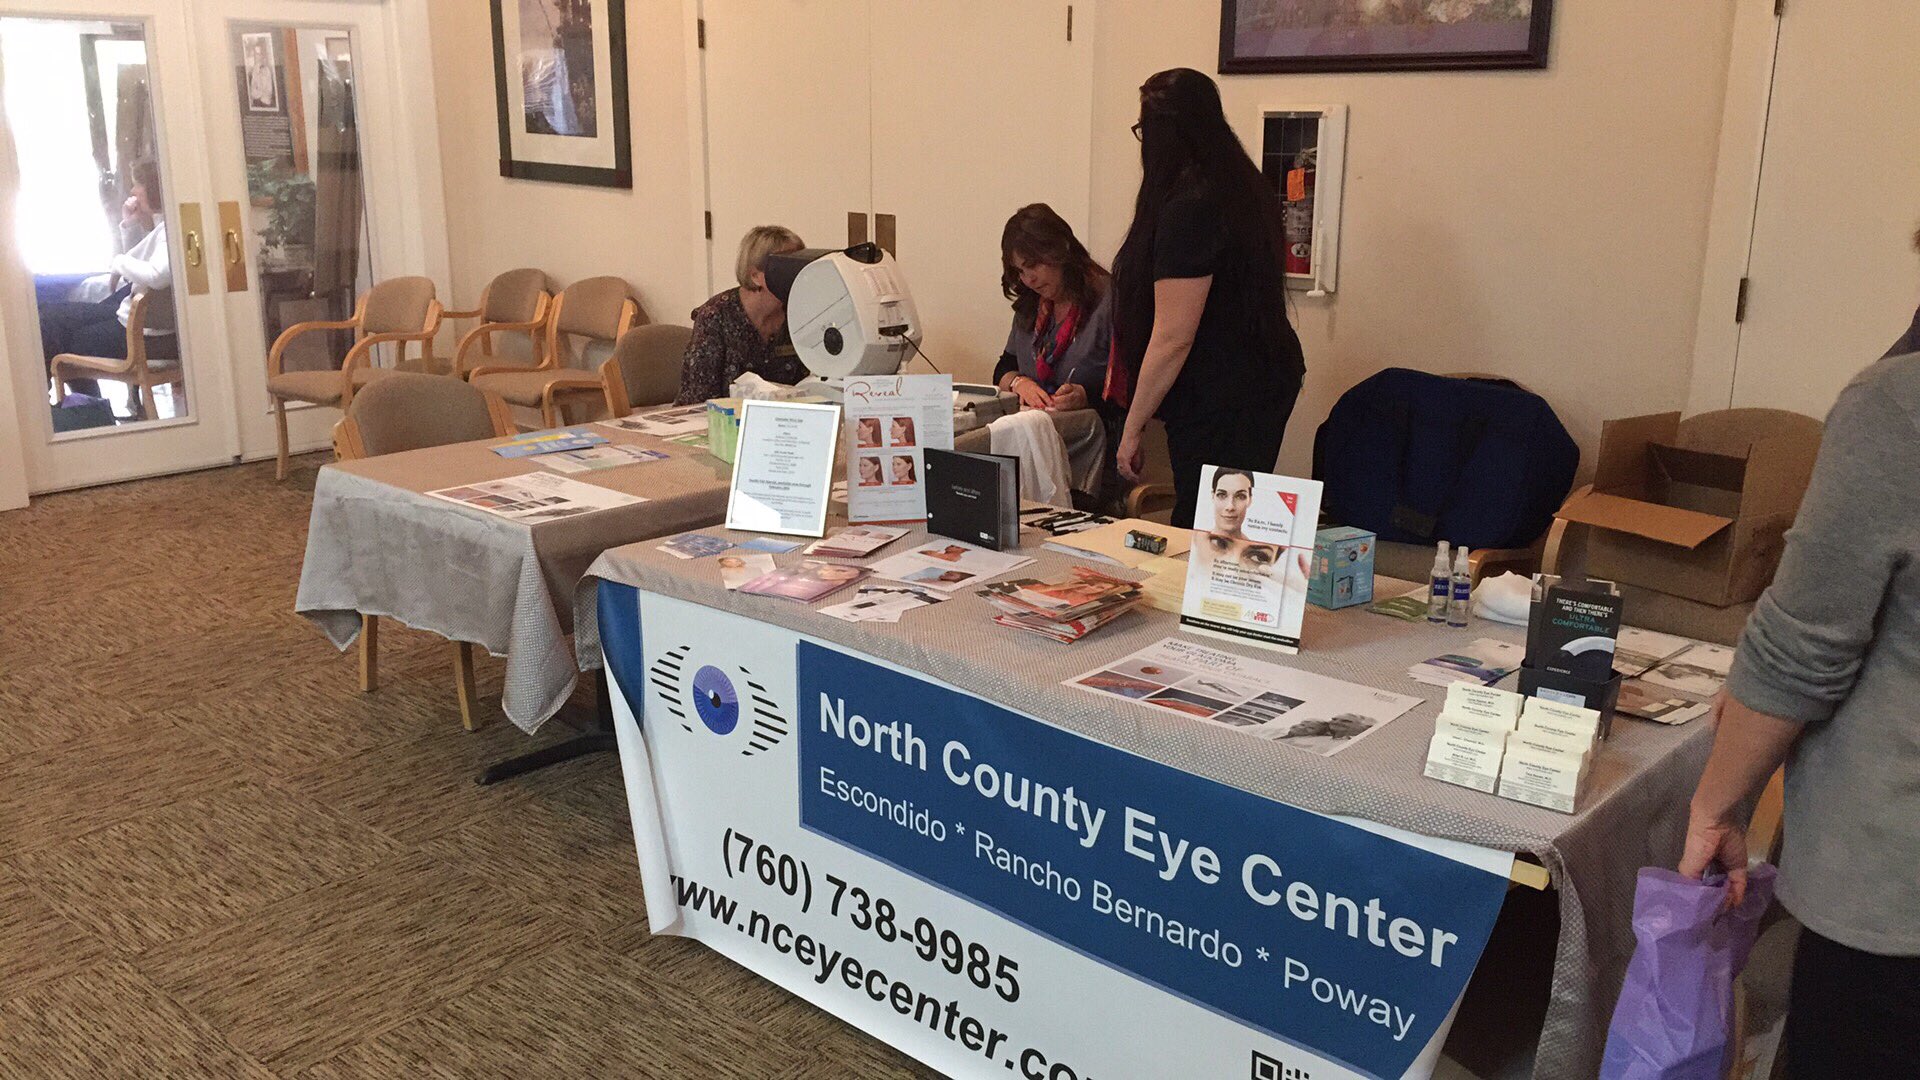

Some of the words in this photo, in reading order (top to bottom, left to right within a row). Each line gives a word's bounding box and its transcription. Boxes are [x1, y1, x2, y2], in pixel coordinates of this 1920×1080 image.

[846, 376, 903, 404] Reveal
[1556, 597, 1577, 607] THERE'S
[1574, 606, 1587, 614] THEN
[1587, 608, 1609, 618] THERE'S
[1552, 617, 1611, 634] COMFORTABLE
[1569, 613, 1596, 623] ULTRA
[820, 692, 927, 772] North
[942, 740, 1106, 848] County
[1124, 806, 1221, 885] Eye
[1241, 853, 1458, 968] Center
[722, 827, 812, 914] (760)
[826, 873, 1020, 1003] 738-9985
[820, 766, 947, 843] Escondido
[975, 830, 1081, 902] Rancho
[1093, 880, 1243, 968] Bernardo
[1284, 956, 1416, 1041] Poway
[670, 875, 1094, 1080] ww.nceyecenter.co
